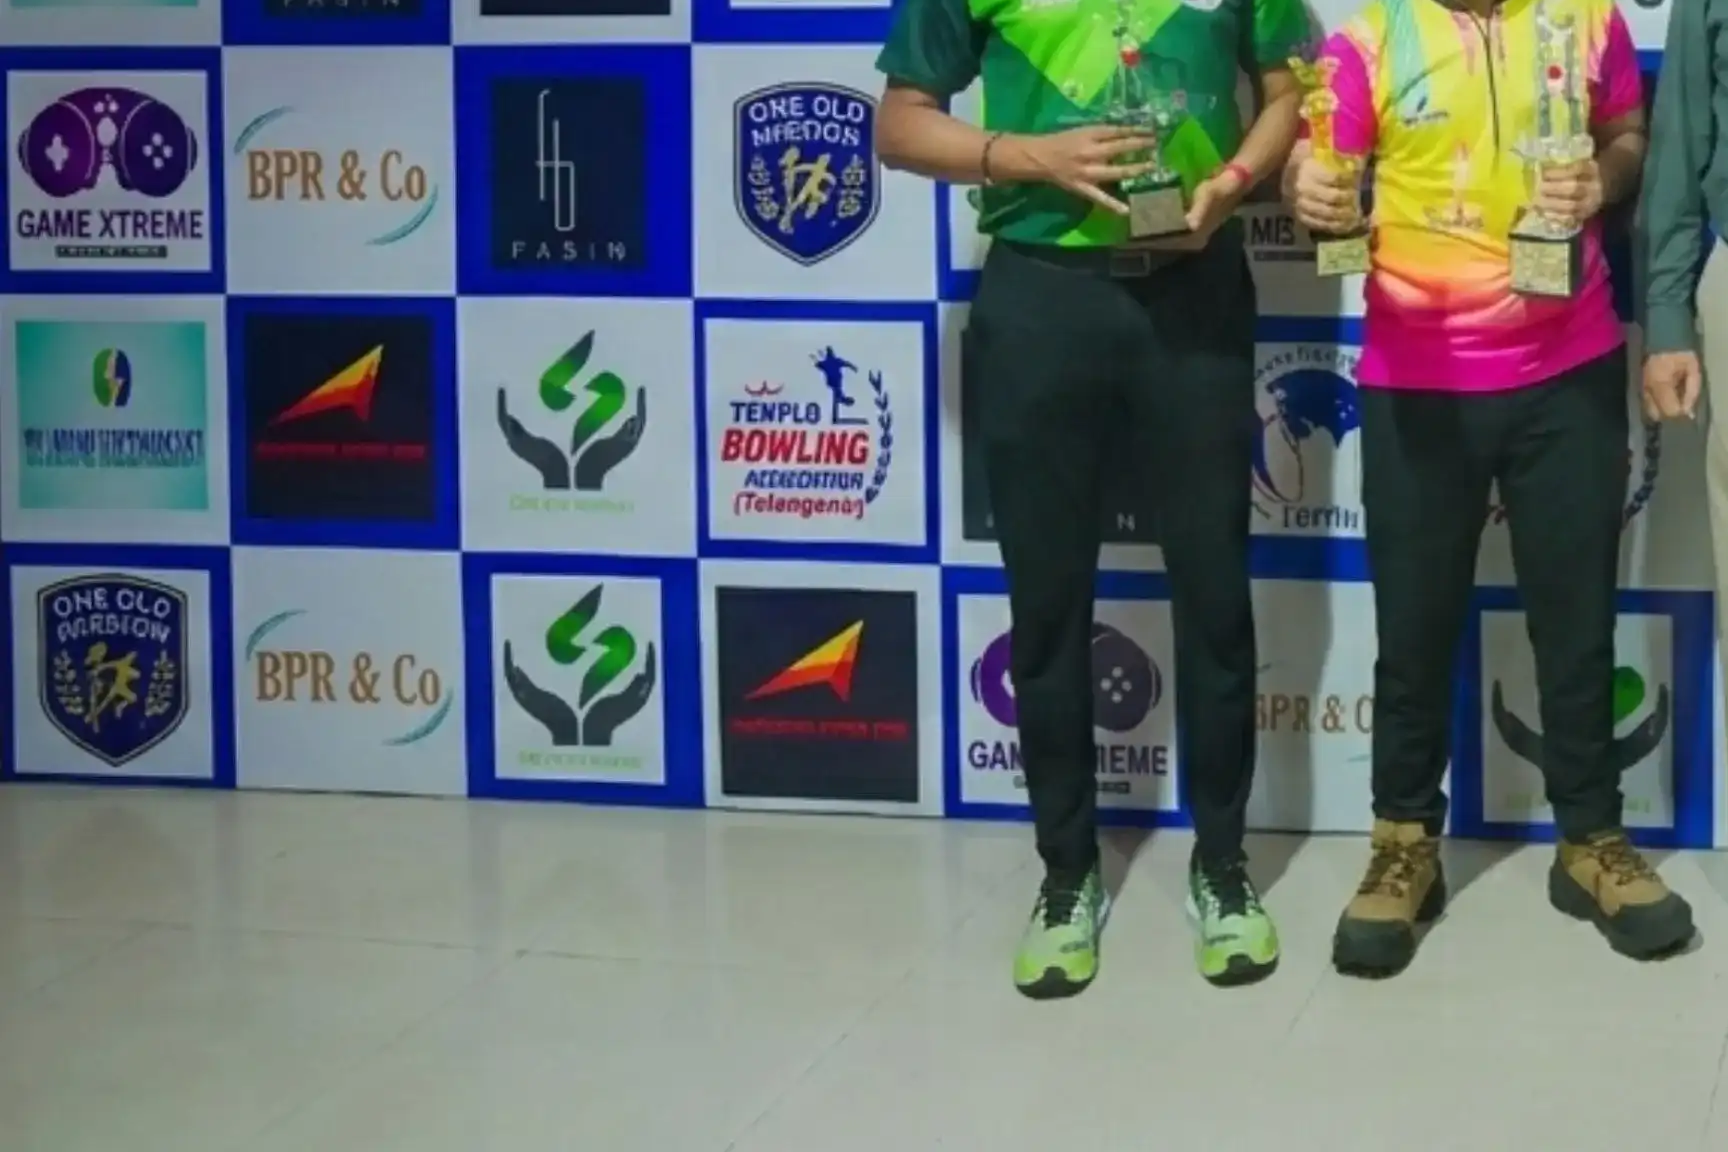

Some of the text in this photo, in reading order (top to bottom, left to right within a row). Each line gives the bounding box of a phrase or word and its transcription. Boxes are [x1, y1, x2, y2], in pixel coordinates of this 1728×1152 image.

[247, 151, 426, 201] BPR & Co
[17, 209, 203, 239] GAME XTREME
[721, 429, 869, 465] BOWLING
[256, 651, 440, 705] BPR & Co
[1321, 698, 1347, 733] &
[1356, 698, 1374, 733] C
